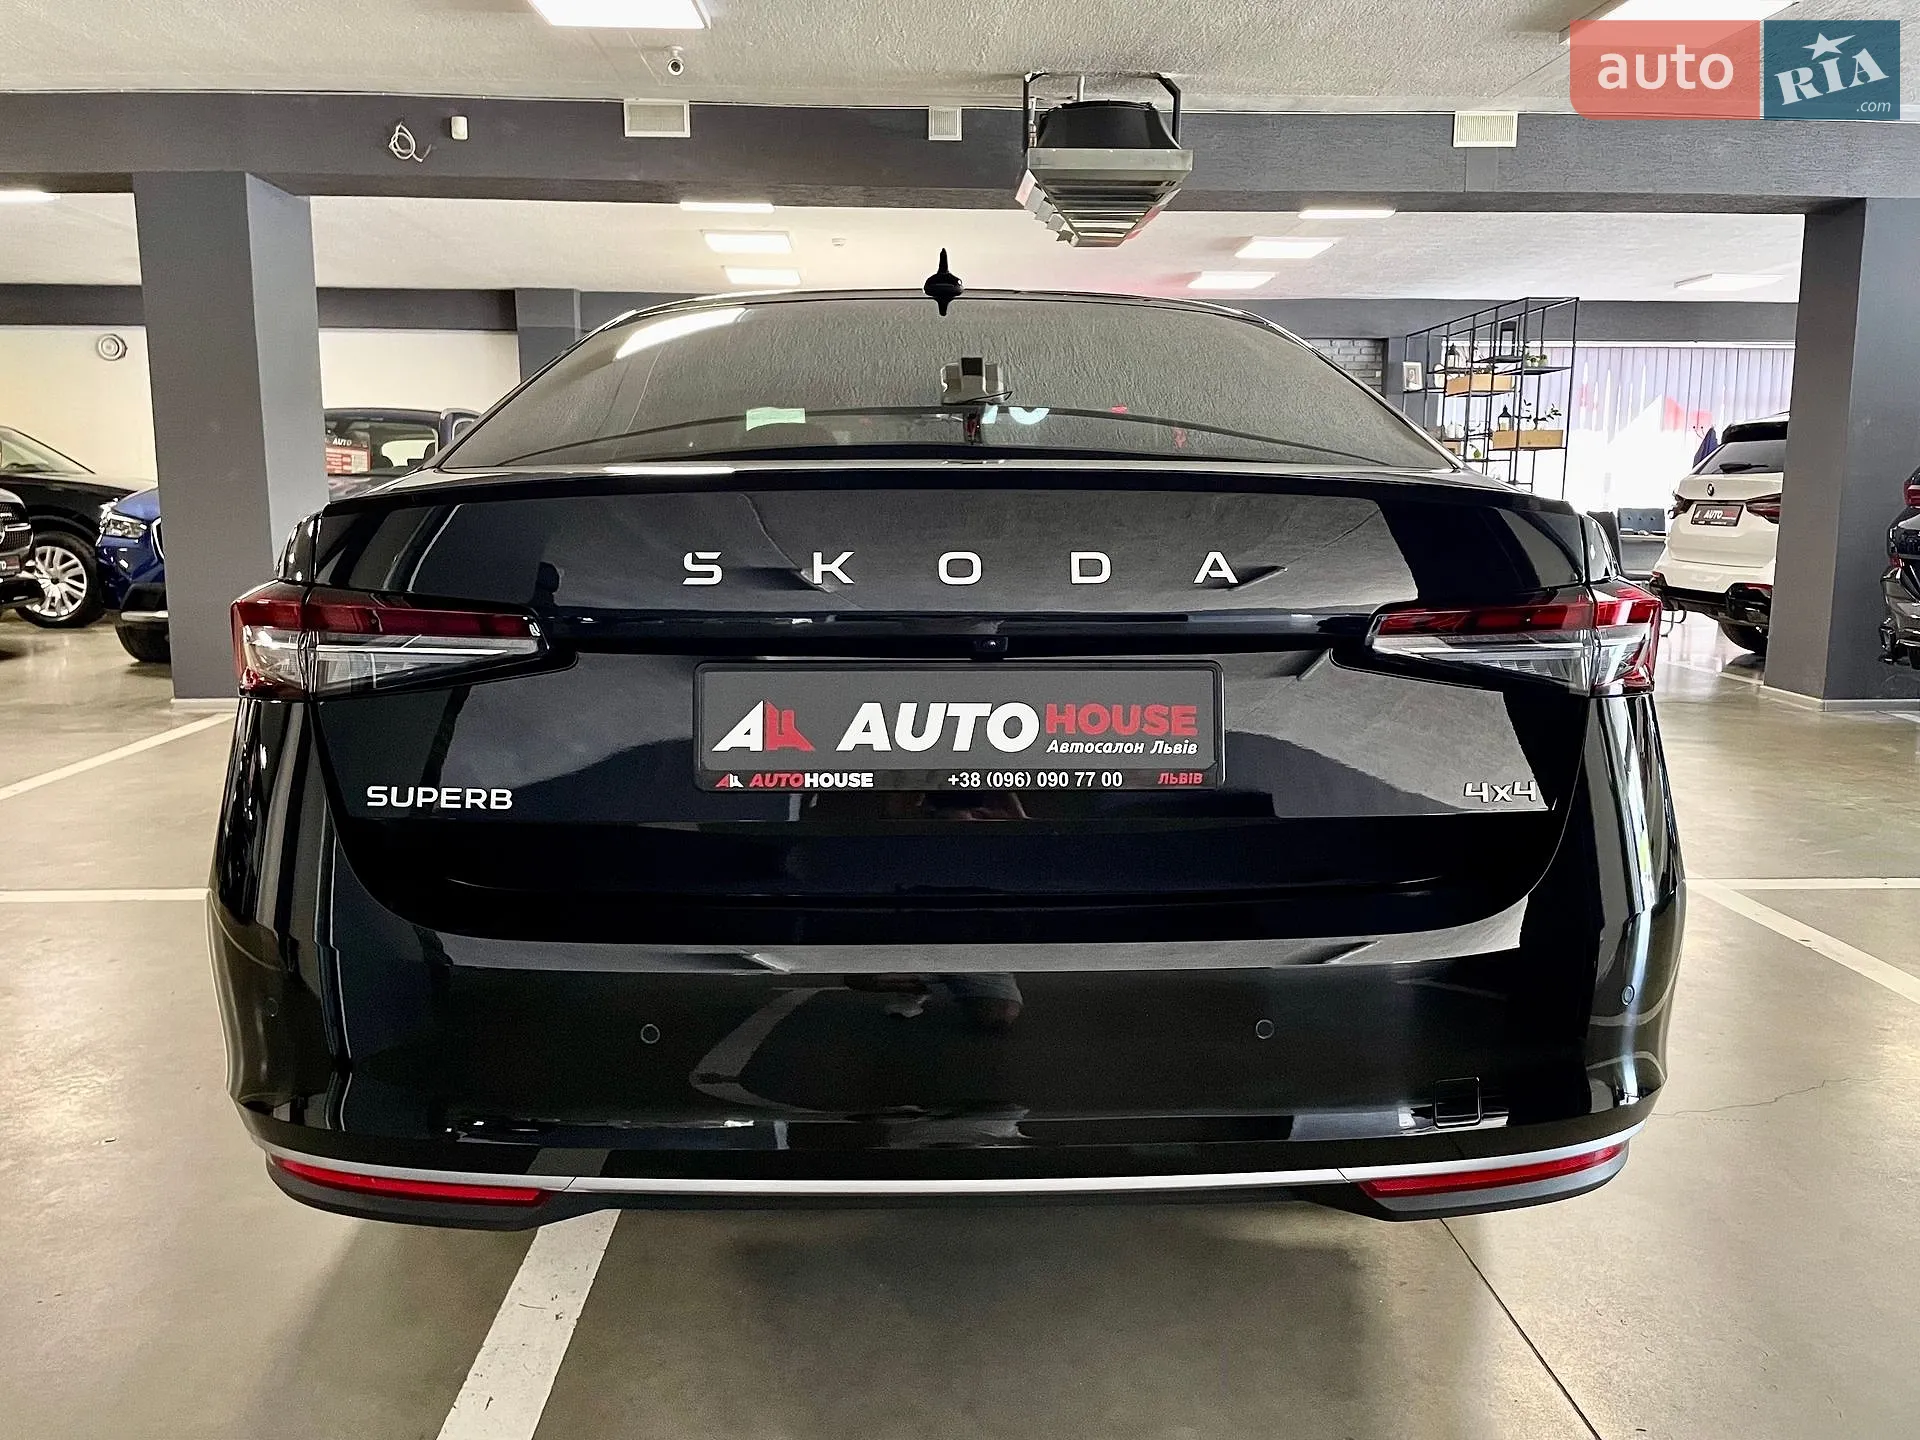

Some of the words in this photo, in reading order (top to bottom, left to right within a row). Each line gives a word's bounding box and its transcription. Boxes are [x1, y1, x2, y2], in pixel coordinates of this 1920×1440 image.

[682, 551, 1239, 586] SKODA
[835, 701, 1041, 753] AUTO
[1045, 703, 1199, 736] HOUSE
[1046, 739, 1145, 754] Автосалон
[1150, 739, 1198, 755] Львів
[750, 772, 874, 788] AUTOHOUSE
[947, 772, 981, 787] +38
[986, 771, 1032, 788] (096)
[1036, 772, 1069, 787] 090
[1074, 772, 1096, 787] 77
[1101, 772, 1123, 787] 00
[366, 785, 513, 810] SUPERB
[1463, 781, 1537, 803] 4x4
